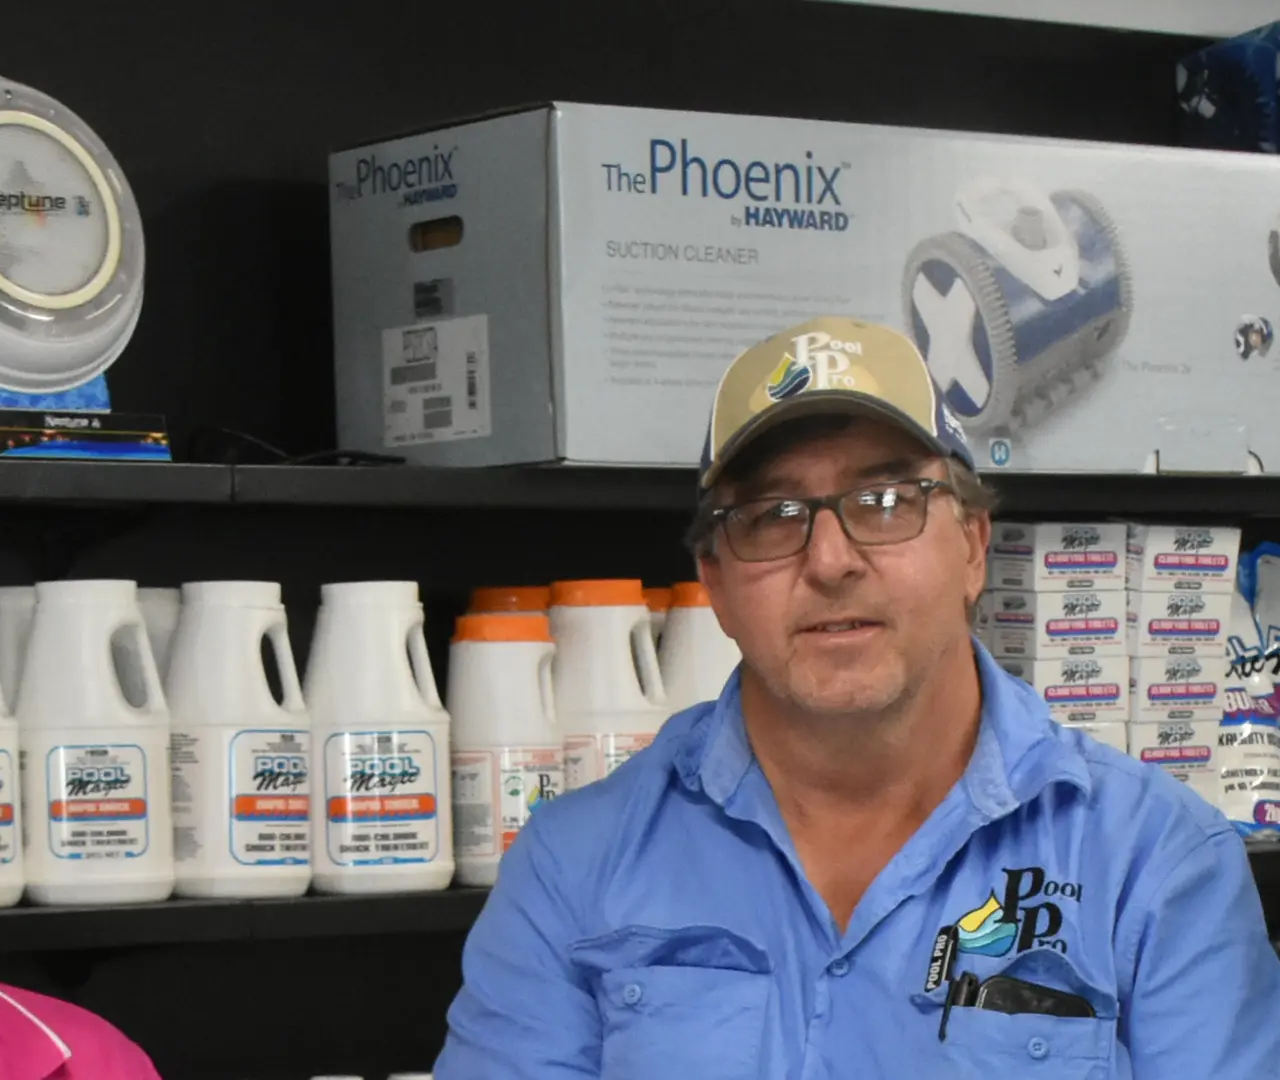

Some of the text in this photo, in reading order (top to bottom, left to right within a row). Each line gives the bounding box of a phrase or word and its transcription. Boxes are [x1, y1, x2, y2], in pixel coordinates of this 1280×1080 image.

[356, 145, 455, 197] Phoenix
[601, 138, 841, 205] The Phoenix
[744, 206, 849, 231] HAYWARD
[606, 240, 759, 265] SUCTION CLEANER
[791, 332, 863, 367] Pool
[813, 351, 855, 390] Pro
[66, 766, 132, 785] POOL
[343, 771, 419, 792] Magic
[349, 755, 420, 777] POOL
[65, 779, 131, 798] Magic
[993, 866, 1085, 925] Pool
[1016, 901, 1069, 955] Pro
[926, 933, 949, 990] POOL PRO
